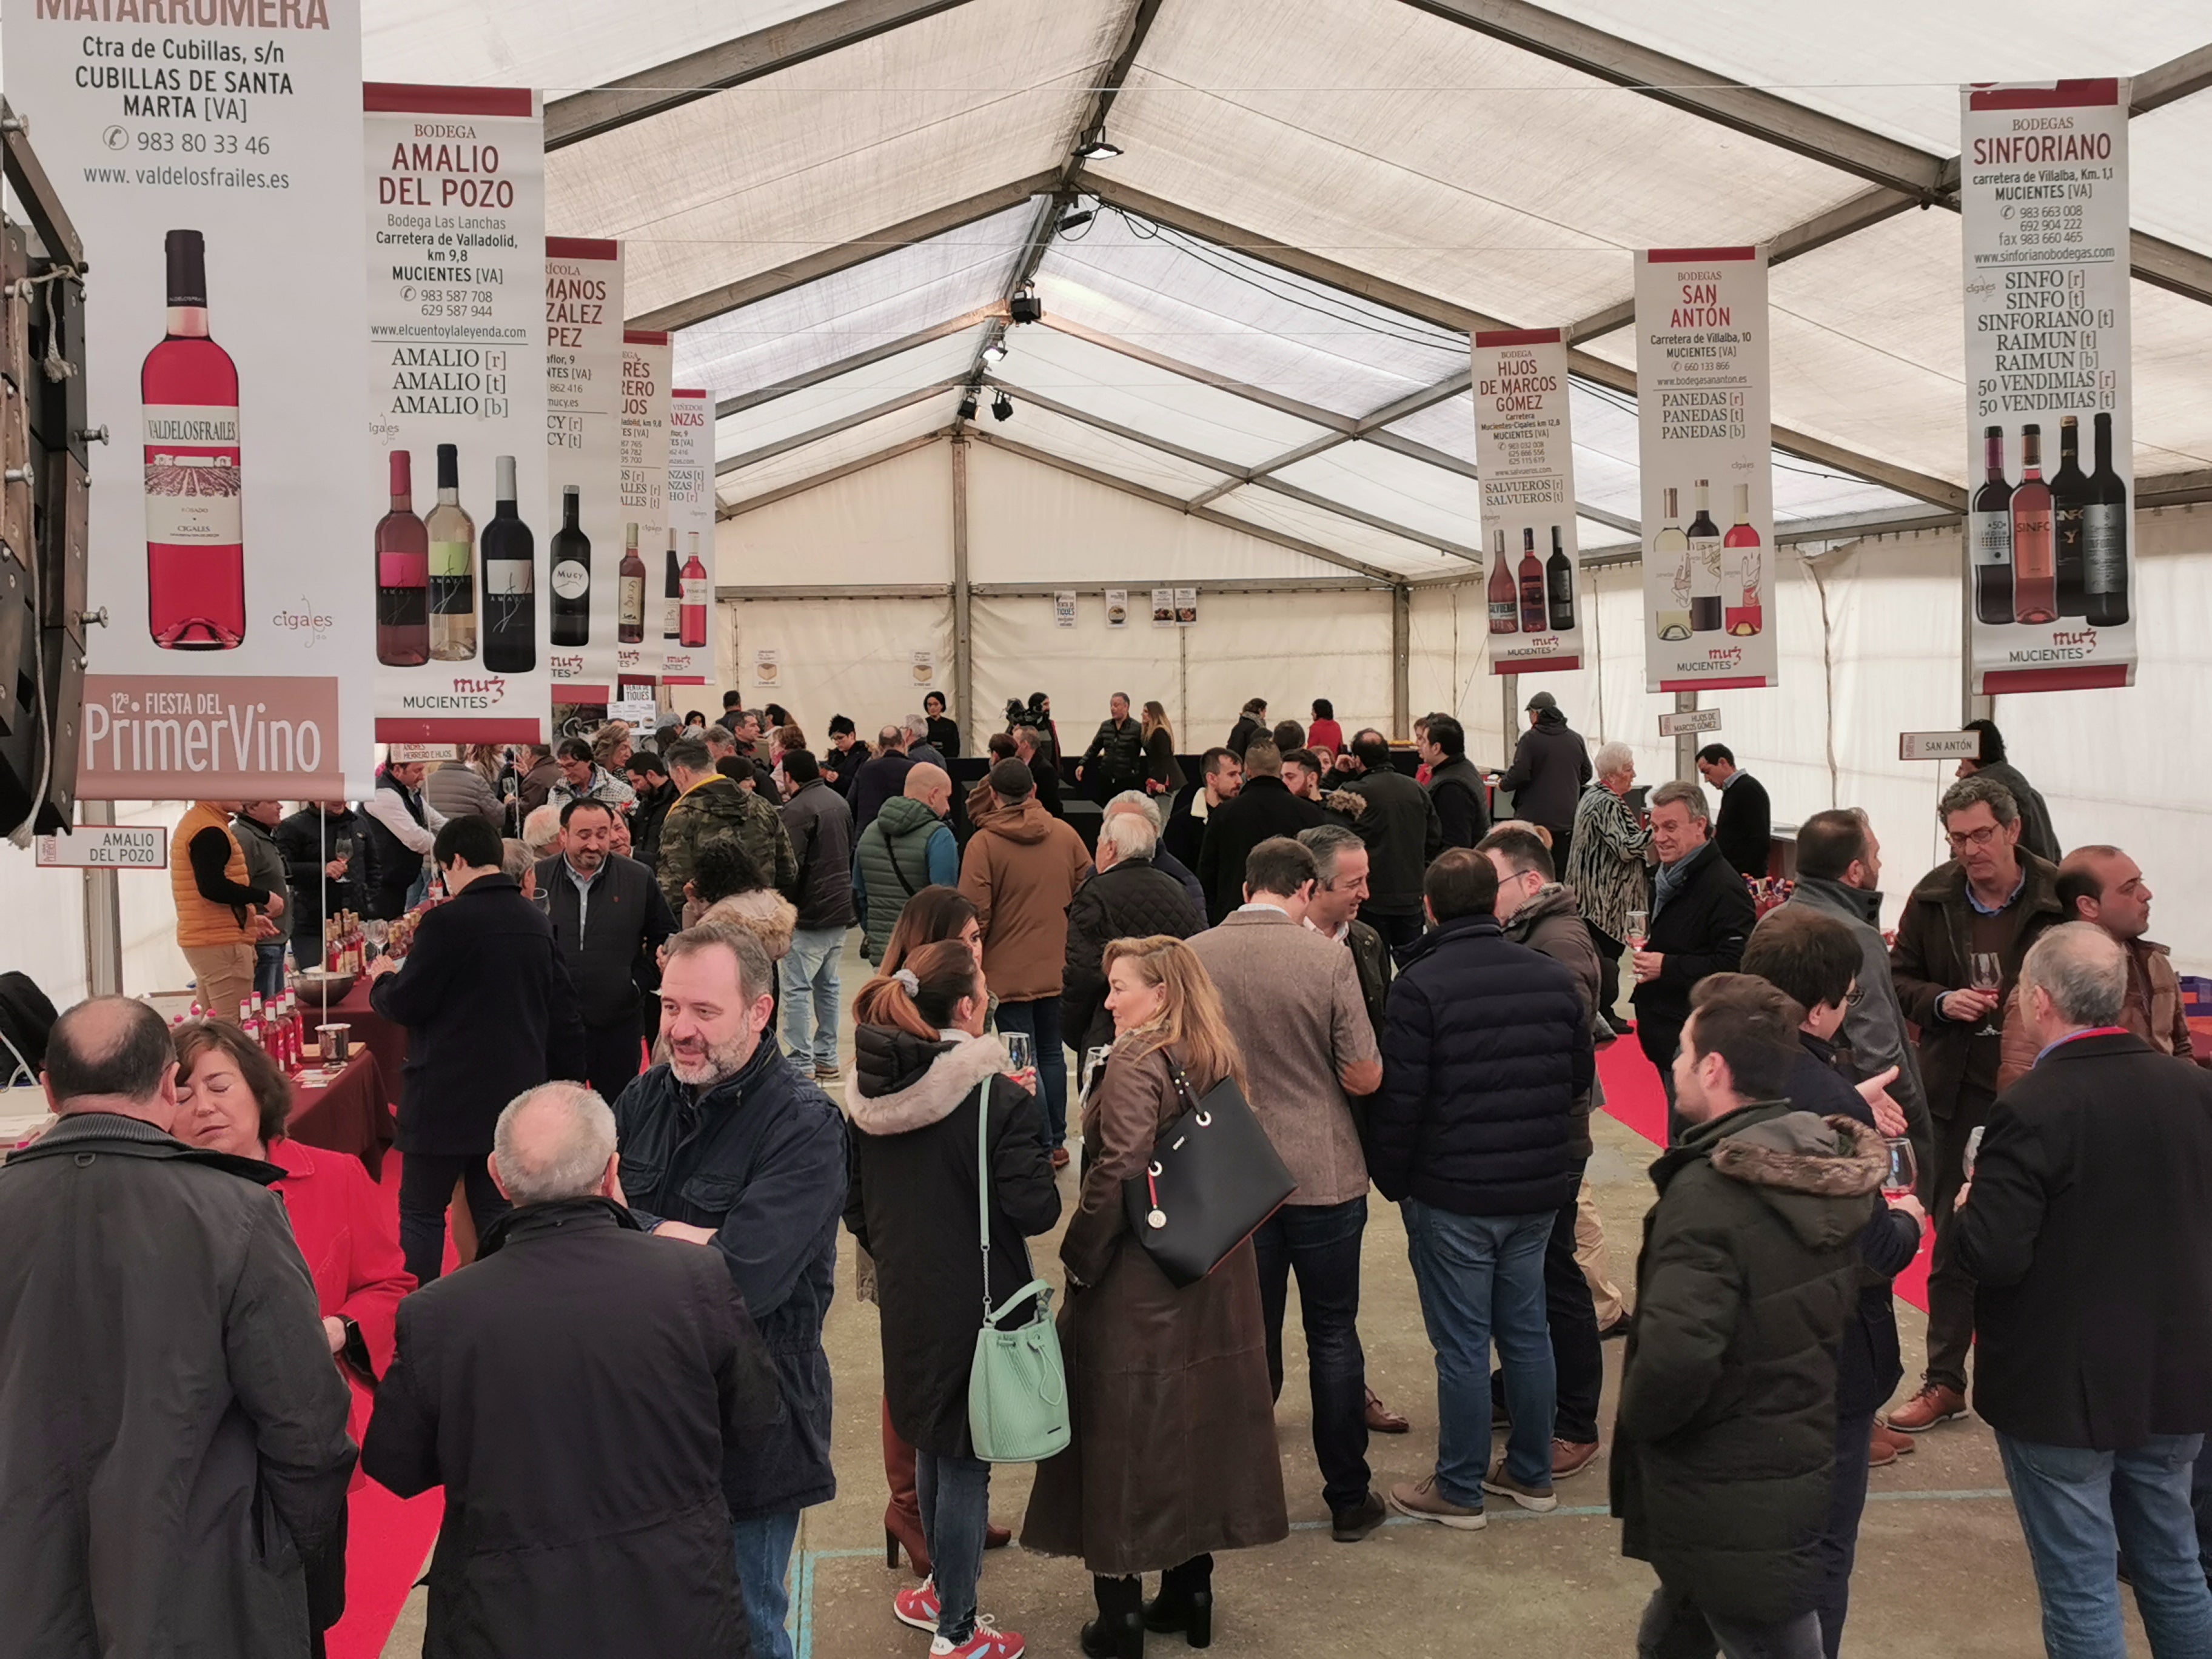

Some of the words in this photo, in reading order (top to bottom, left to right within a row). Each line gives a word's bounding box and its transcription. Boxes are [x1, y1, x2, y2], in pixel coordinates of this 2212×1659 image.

[82, 36, 123, 58] Ctra
[132, 38, 155, 59] de
[163, 39, 246, 64] Cubillas,
[254, 41, 284, 63] s/n
[76, 66, 180, 90] CUBILLAS
[190, 70, 216, 92] DE
[225, 72, 293, 95] SANTA
[124, 95, 196, 118] MARTA
[205, 97, 247, 122] [VA]
[414, 124, 477, 139] BODEGA
[2013, 117, 2074, 131] BODEGAS
[138, 132, 174, 152] 983
[182, 133, 206, 153] 80
[213, 134, 238, 153] 33
[246, 135, 270, 155] 46
[1974, 133, 2111, 165] SINFORIANO
[392, 143, 498, 173] AMALIO
[1973, 172, 2020, 185] carretera
[2023, 170, 2036, 182] de
[2039, 169, 2078, 182] Villalba,
[2081, 169, 2100, 181] Km.
[379, 177, 431, 206] DEL
[443, 179, 514, 208] POZO
[1996, 185, 2064, 201] MUCIENTES
[2068, 183, 2093, 199] [VA]
[2020, 207, 2039, 218] 983
[2042, 206, 2060, 218] 663
[2063, 205, 2083, 216] 008
[387, 214, 431, 231] Bodega
[435, 216, 455, 228] Las
[458, 216, 506, 230] Lanchas
[2020, 220, 2039, 232] 692
[2042, 219, 2061, 230] 904
[2063, 218, 2082, 230] 222
[376, 232, 434, 246] Carretera
[438, 233, 453, 246] de
[457, 233, 518, 249] Valladolid,
[1999, 232, 2017, 246] fax
[2020, 233, 2039, 244] 983
[2042, 232, 2061, 243] 660
[427, 249, 446, 262] km
[449, 250, 468, 264] 9,8
[1974, 247, 2114, 263] www.sinforianobodegas.com
[392, 266, 471, 282] MUCIENTES
[476, 268, 503, 284] [VA]
[1678, 271, 1723, 281] BODEGAS
[2005, 270, 2064, 289] SINFO
[421, 290, 443, 301] 983
[446, 290, 468, 302] 587
[471, 291, 492, 303] 708
[1683, 284, 1717, 304] SAN
[2006, 290, 2064, 309] SINFO
[421, 304, 443, 316] 629
[446, 305, 468, 317] 587
[471, 306, 492, 317] 944
[1671, 304, 1731, 328] ANTÓN
[1978, 309, 2094, 331] SINFORIANO
[371, 324, 526, 340] www.elcuentoylaleyenda.com
[548, 326, 581, 347] PEZ
[1651, 334, 1691, 345] Carretera
[1694, 333, 1704, 344] de
[1707, 332, 1740, 344] Villalba,
[1743, 332, 1751, 342] 10
[1997, 331, 2076, 351] RAIMUN
[391, 348, 480, 367] AMALIO
[486, 351, 506, 370] [r]
[569, 355, 575, 364] 9
[1667, 347, 1717, 358] MUCIENTES
[1498, 360, 1537, 377] HIJOS
[1995, 352, 2075, 371] RAIMUN
[392, 372, 480, 391] AMALIO
[486, 374, 506, 394] [t]
[1480, 380, 1497, 395] DE
[1502, 377, 1557, 395] MARCOS
[1978, 379, 1997, 396] 50
[2000, 370, 2095, 391] VENDIMIAS
[390, 397, 478, 415] AMALIO
[484, 398, 508, 418] [b]
[1496, 394, 1543, 412] GÓMEZ
[1662, 393, 1726, 407] PANEDAS
[1979, 400, 1997, 417] 50
[2001, 391, 2096, 412] VENDIMIAS
[1663, 409, 1727, 423] PANEDAS
[148, 420, 235, 440] VALDELOSFRAILES
[1493, 429, 1533, 440] MUCIENTES
[1662, 425, 1726, 439] PANEDAS
[1486, 480, 1551, 494] SALVUEROS
[1486, 492, 1552, 506] SALVUEROS
[2009, 649, 2083, 663] MUCIENTES
[1677, 661, 1731, 672] MUCIENTES
[146, 693, 192, 714] FIESTA
[198, 694, 222, 715] DEL
[403, 696, 488, 709] MUCIENTES
[627, 691, 649, 700] TIQUES
[1925, 742, 1942, 751] SAN
[1944, 739, 1972, 751] ANTÓN
[103, 833, 154, 846] AMALIO
[90, 849, 115, 862] DEL
[119, 850, 154, 862] POZO
